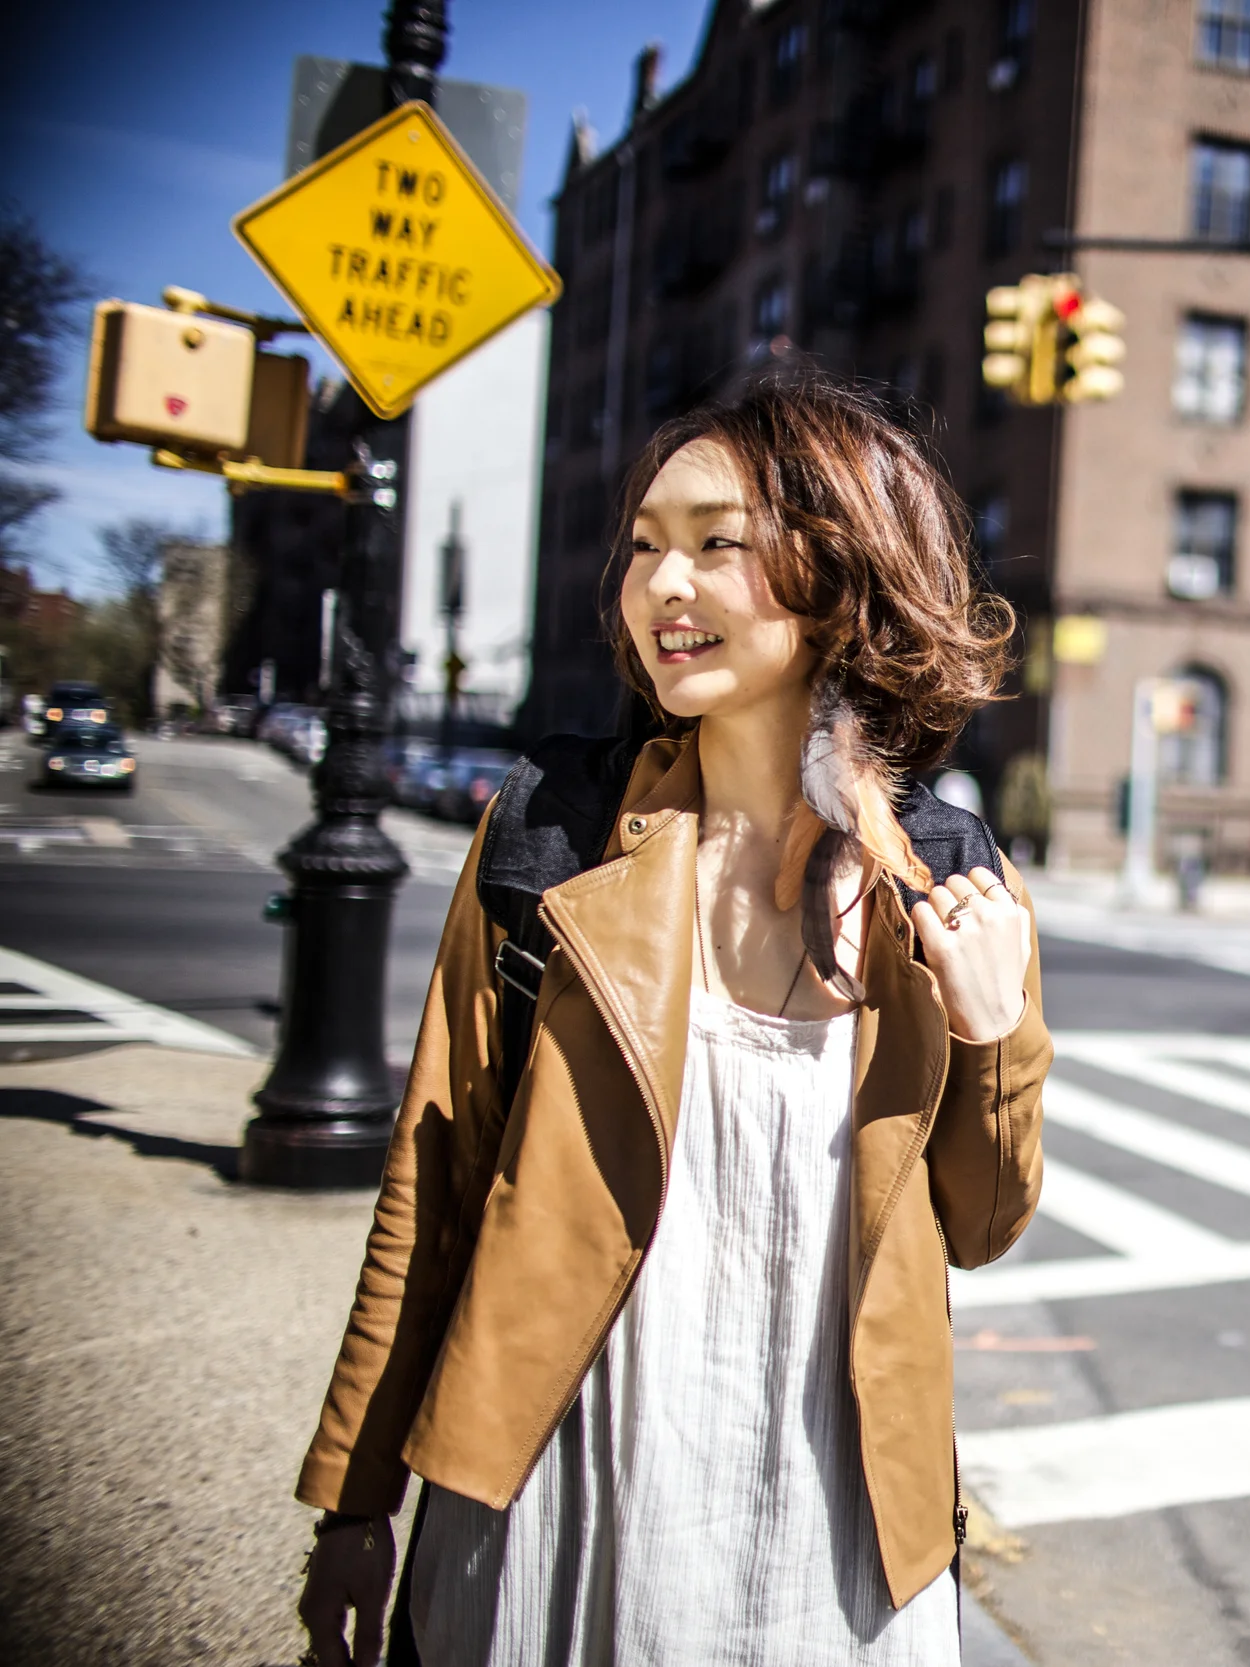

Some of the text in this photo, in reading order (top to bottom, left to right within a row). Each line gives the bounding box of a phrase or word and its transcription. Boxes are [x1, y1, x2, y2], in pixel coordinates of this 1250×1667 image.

[375, 160, 446, 207] TWO
[371, 209, 437, 249] WAY
[328, 244, 471, 304] TRAFFIC
[338, 297, 454, 347] AHEAD
